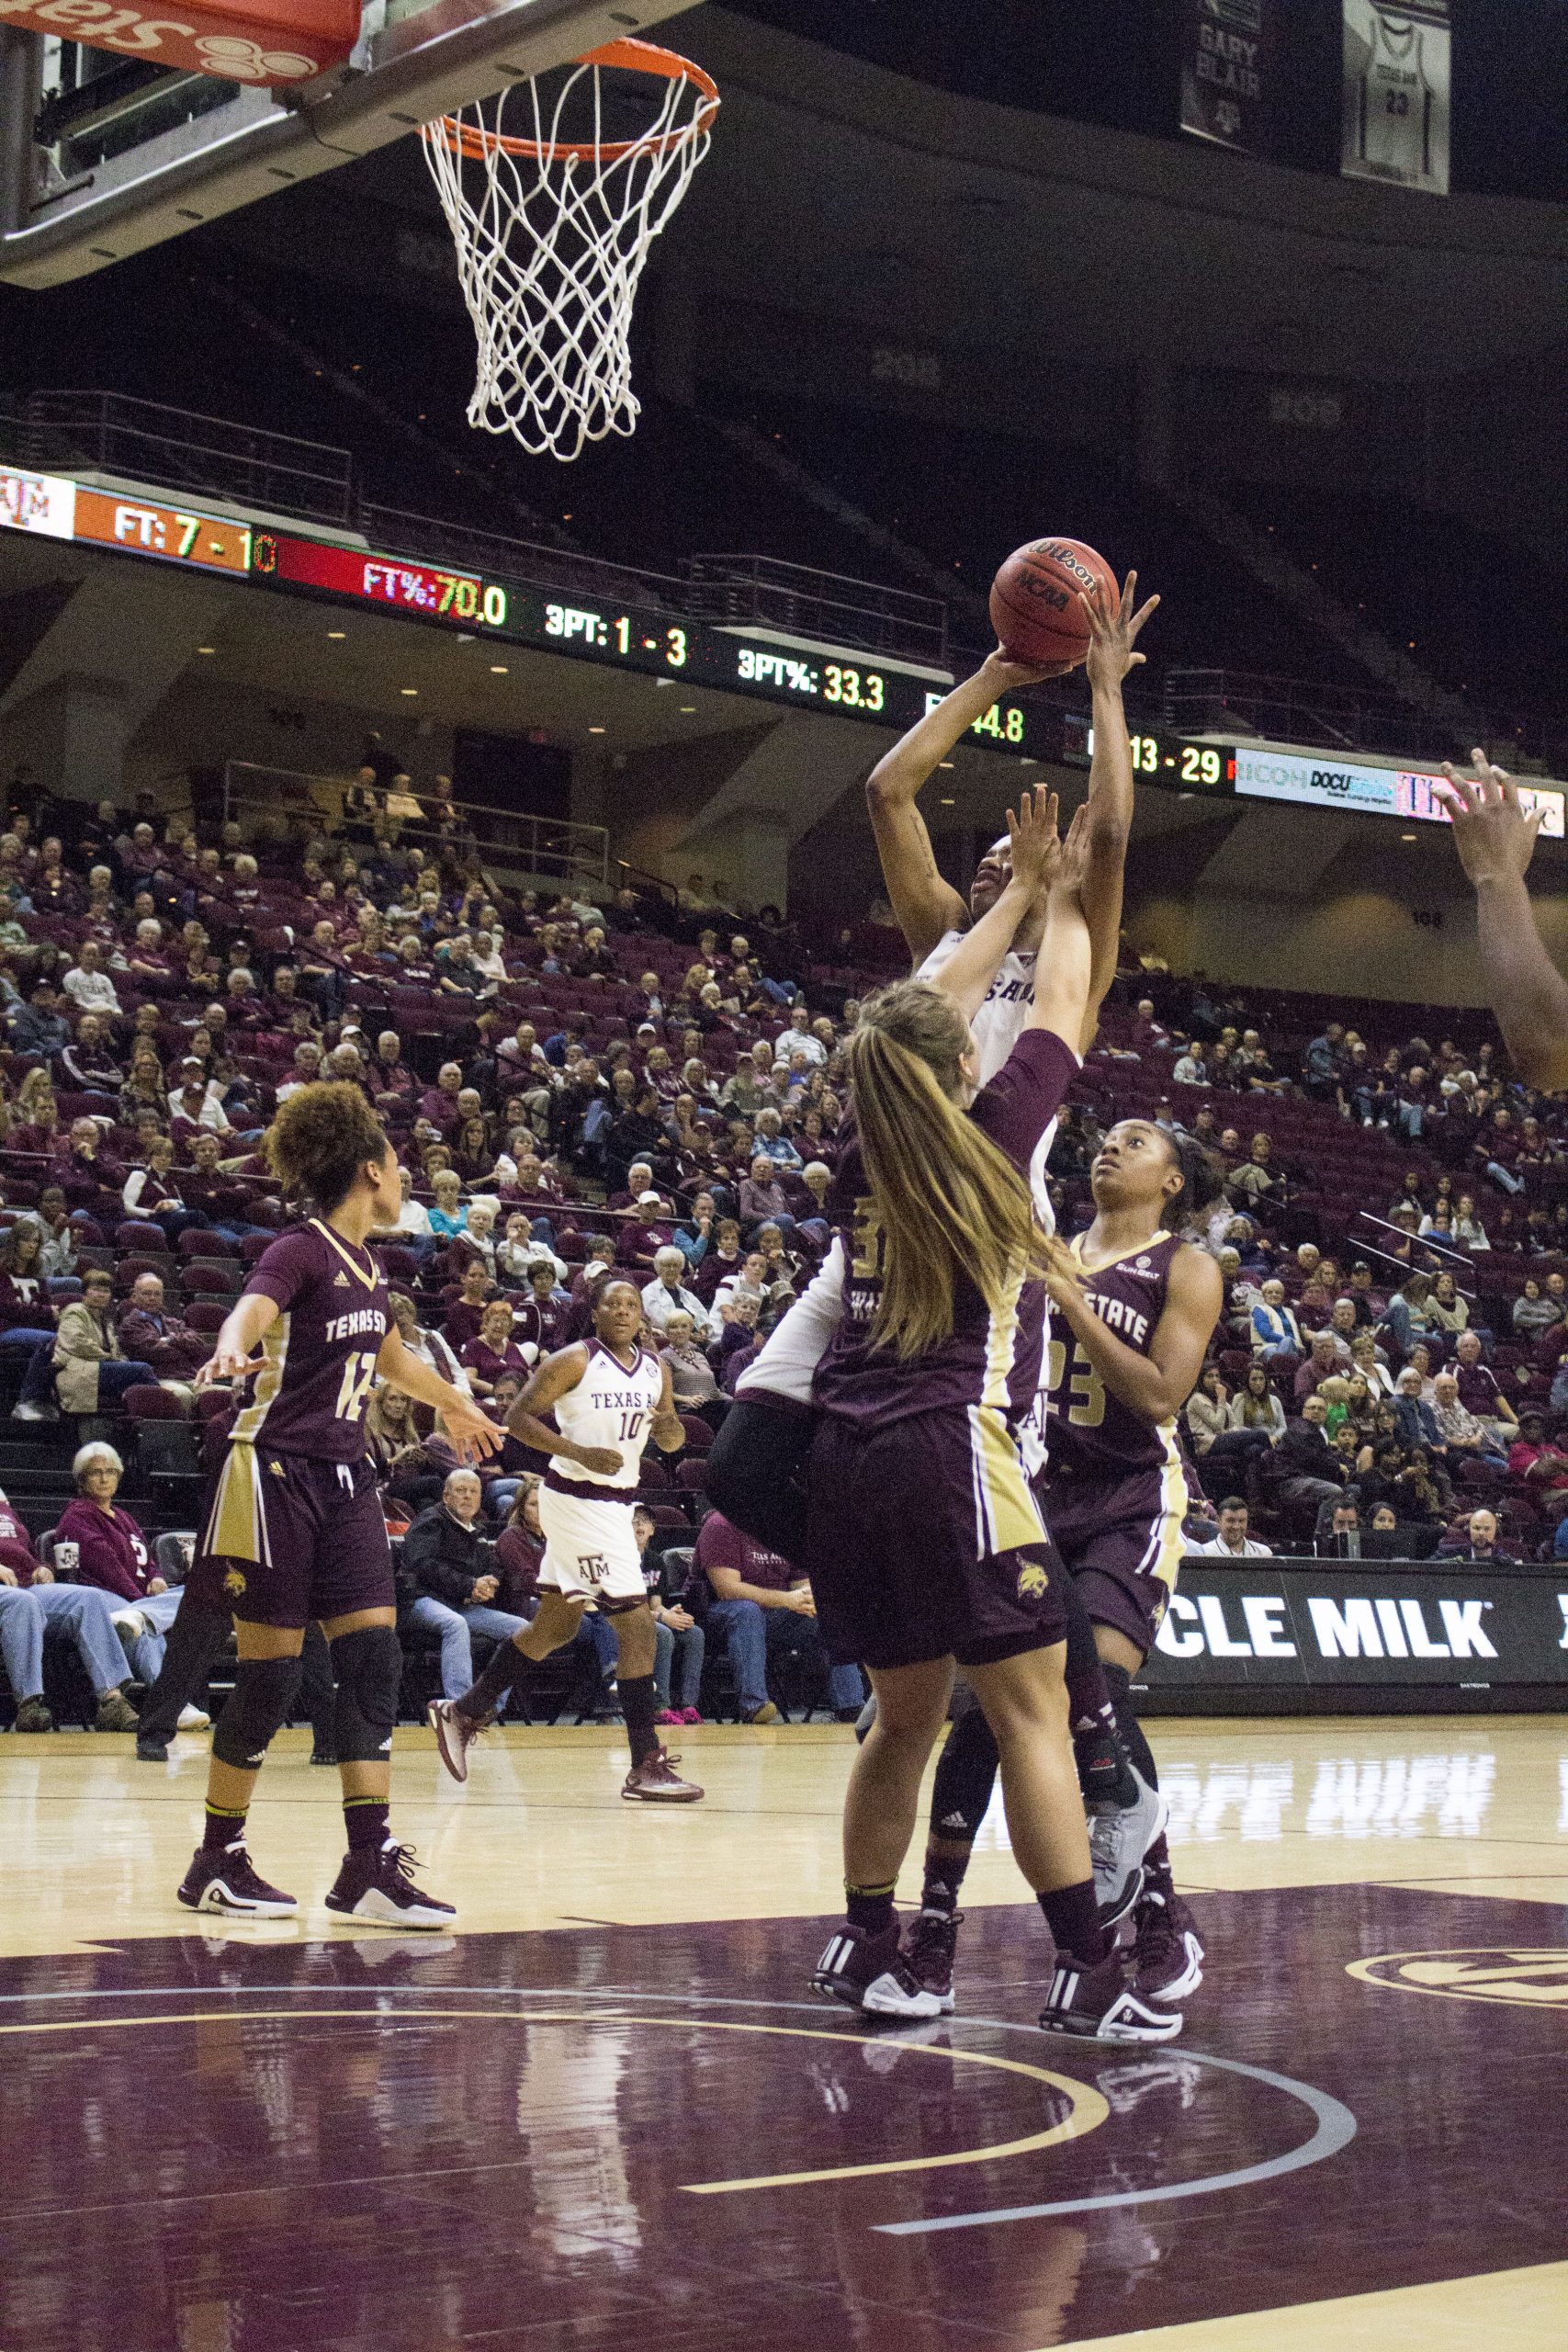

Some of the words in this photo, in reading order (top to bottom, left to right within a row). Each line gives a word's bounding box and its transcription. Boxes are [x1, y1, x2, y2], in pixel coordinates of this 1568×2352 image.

[1201, 23, 1258, 66] GARY
[1196, 51, 1261, 99] BLAIR
[114, 506, 165, 549] FT:
[175, 514, 199, 557] 7
[209, 540, 224, 553] -
[546, 605, 608, 646] 3PT:
[615, 617, 629, 653] 1
[645, 638, 657, 650] -
[667, 628, 687, 666] 3
[739, 649, 818, 694] 3PT%:
[824, 664, 886, 711] 33.3
[1181, 746, 1222, 785] 29
[1227, 760, 1307, 790] RICOH
[325, 1308, 373, 1343] TEXAS
[1084, 1292, 1148, 1345] STATE
[591, 1392, 641, 1409] TEXAS
[618, 1411, 646, 1442] 10
[1308, 1598, 1499, 1658] MILK
